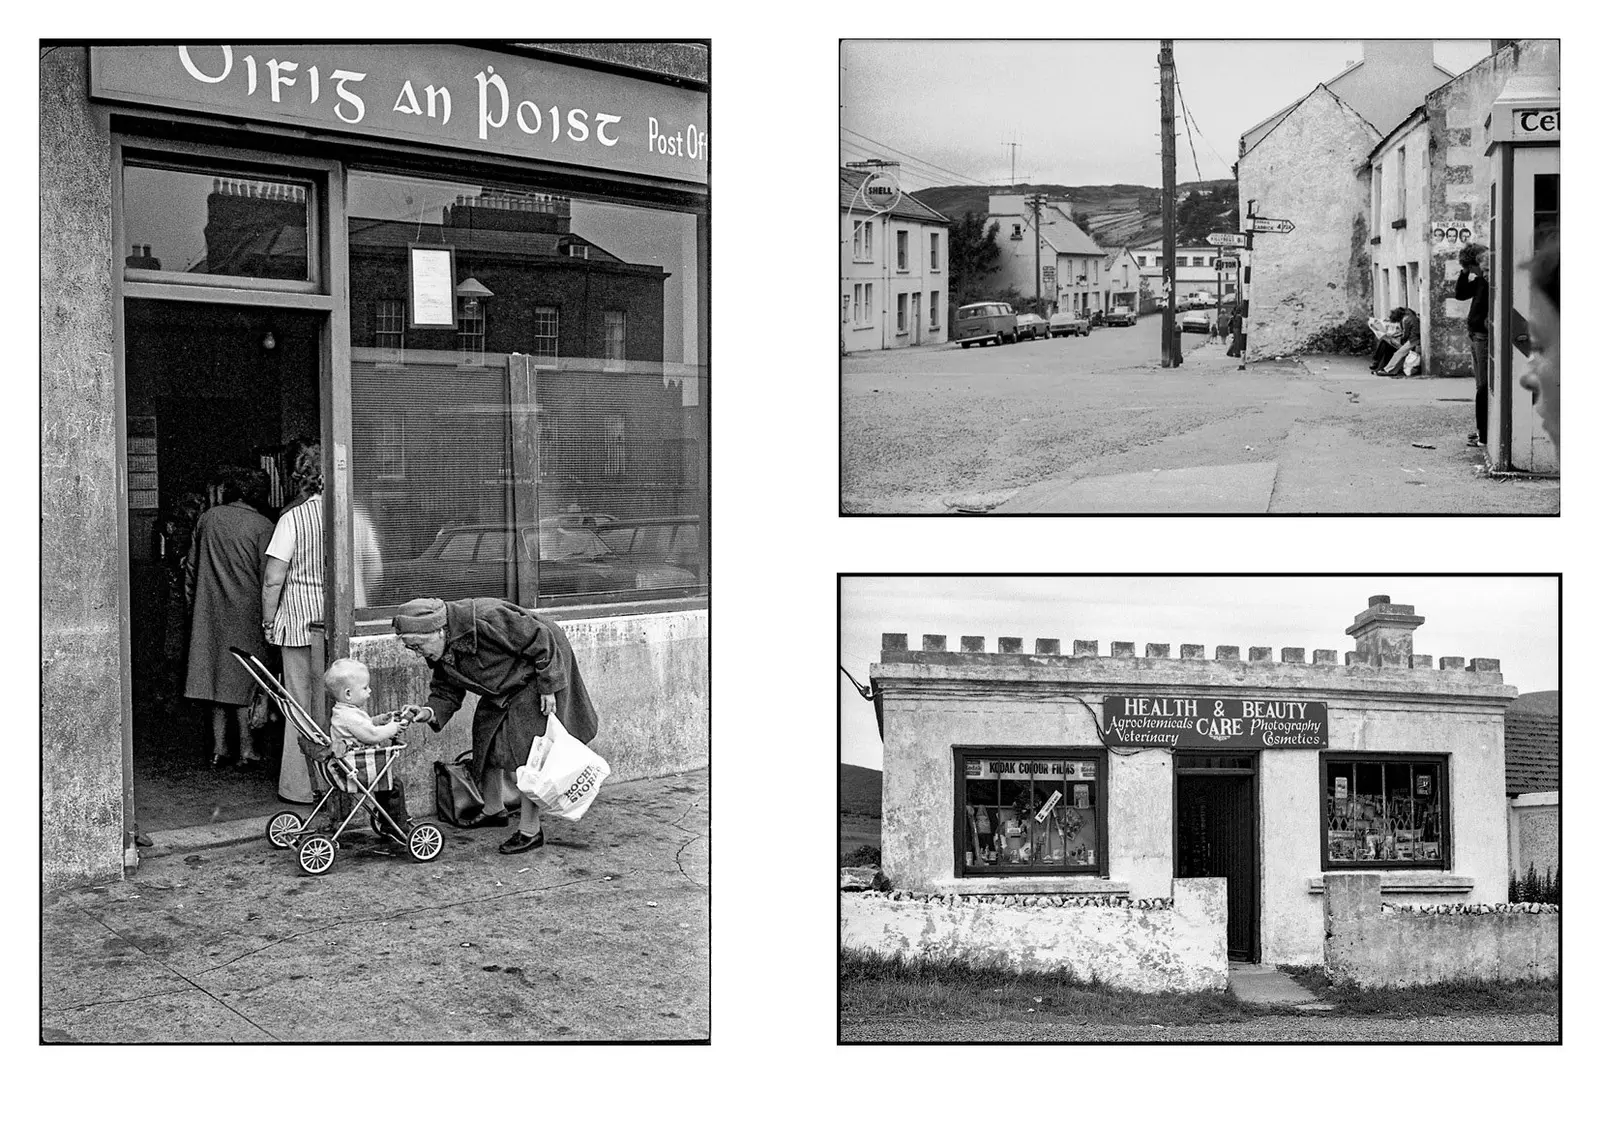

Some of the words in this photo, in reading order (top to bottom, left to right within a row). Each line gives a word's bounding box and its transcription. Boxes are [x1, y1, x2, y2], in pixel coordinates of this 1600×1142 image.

[393, 80, 453, 126] an
[648, 117, 684, 157] Post
[868, 186, 893, 195] SHELL
[1124, 698, 1198, 717] HEALTH
[1213, 700, 1225, 717] &
[1242, 701, 1307, 719] BEAUTY
[1105, 716, 1193, 735] Agrochemicals
[1196, 717, 1244, 735] CARE
[1250, 718, 1322, 736] Photography
[1115, 727, 1179, 747] Veterinary
[1262, 730, 1320, 747] Cosmetics
[989, 762, 1016, 774] KODAK
